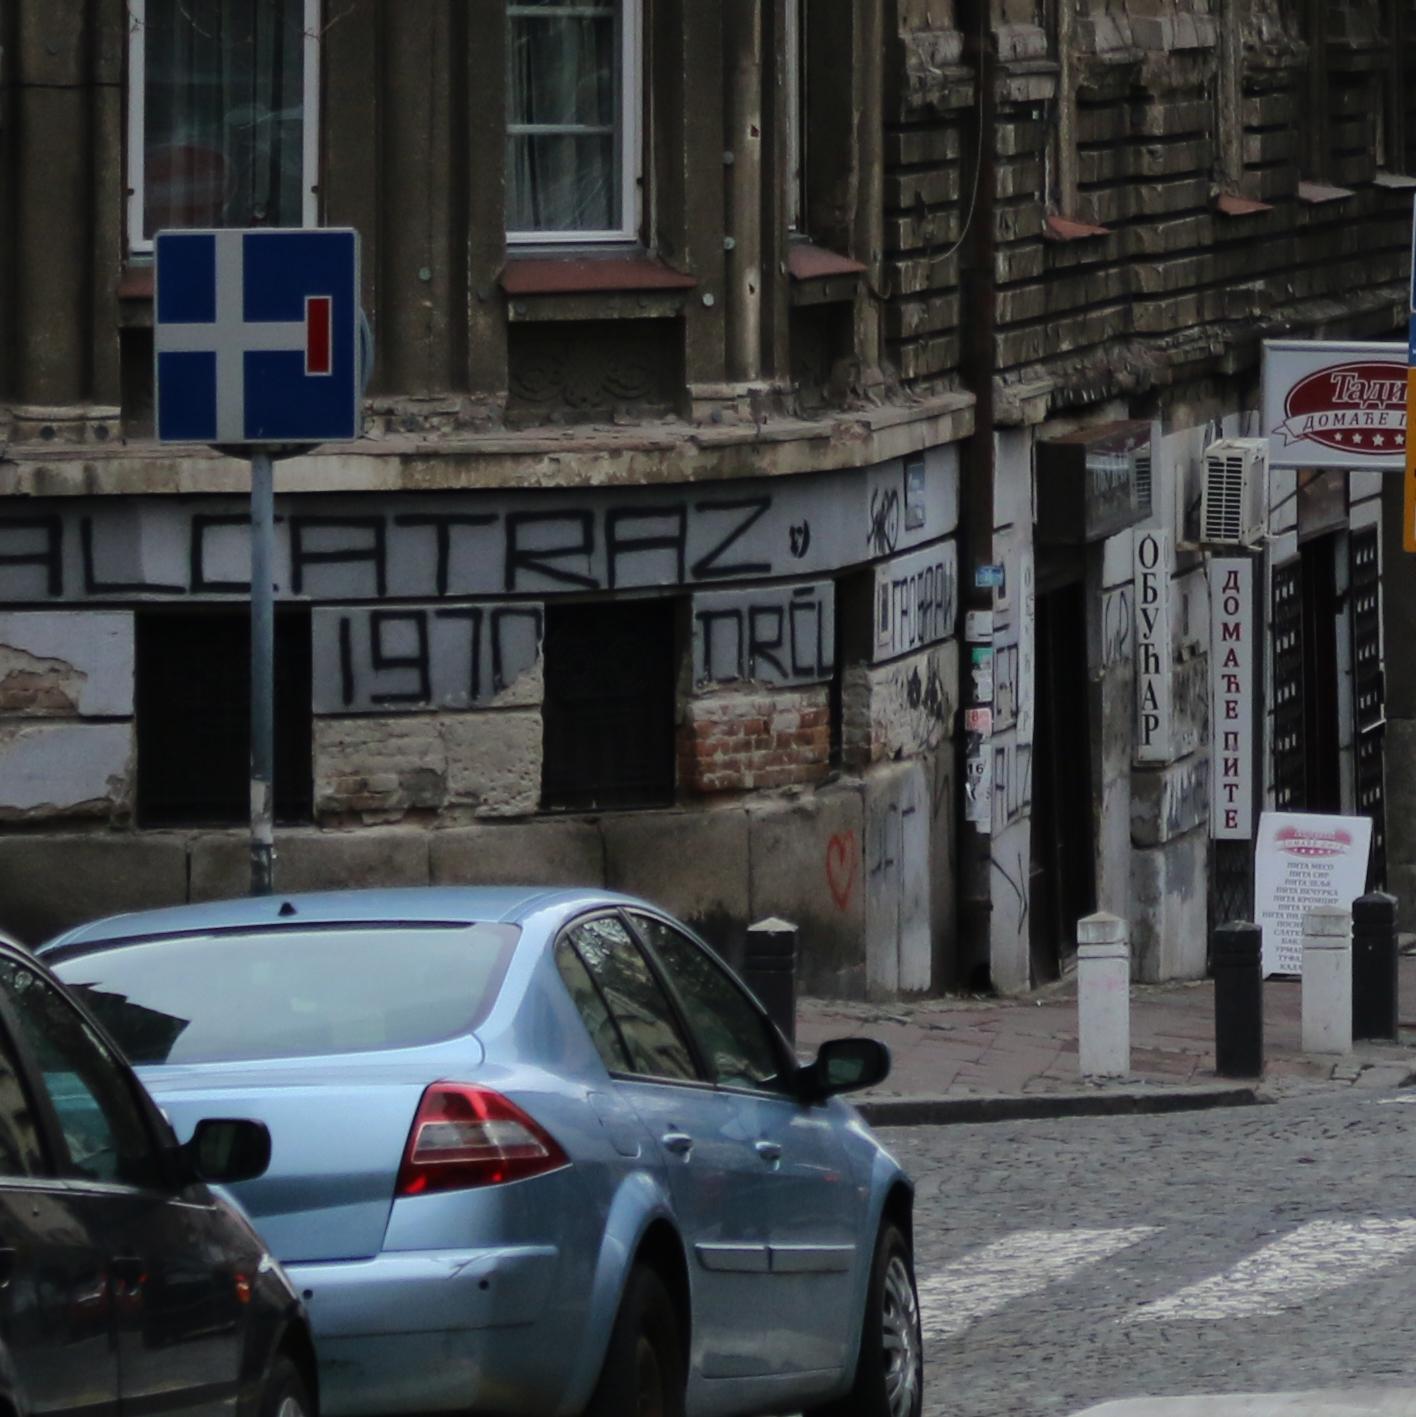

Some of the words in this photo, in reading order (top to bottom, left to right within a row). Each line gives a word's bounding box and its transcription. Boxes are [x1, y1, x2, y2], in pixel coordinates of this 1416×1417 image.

[1303, 412, 1389, 432] ДОМАЋЕ
[1331, 372, 1407, 409] Тади
[1138, 533, 1161, 746] ОБУЋАР
[1222, 570, 1241, 720] ДОМАЋЕ
[1223, 731, 1240, 830] ПИТЕ
